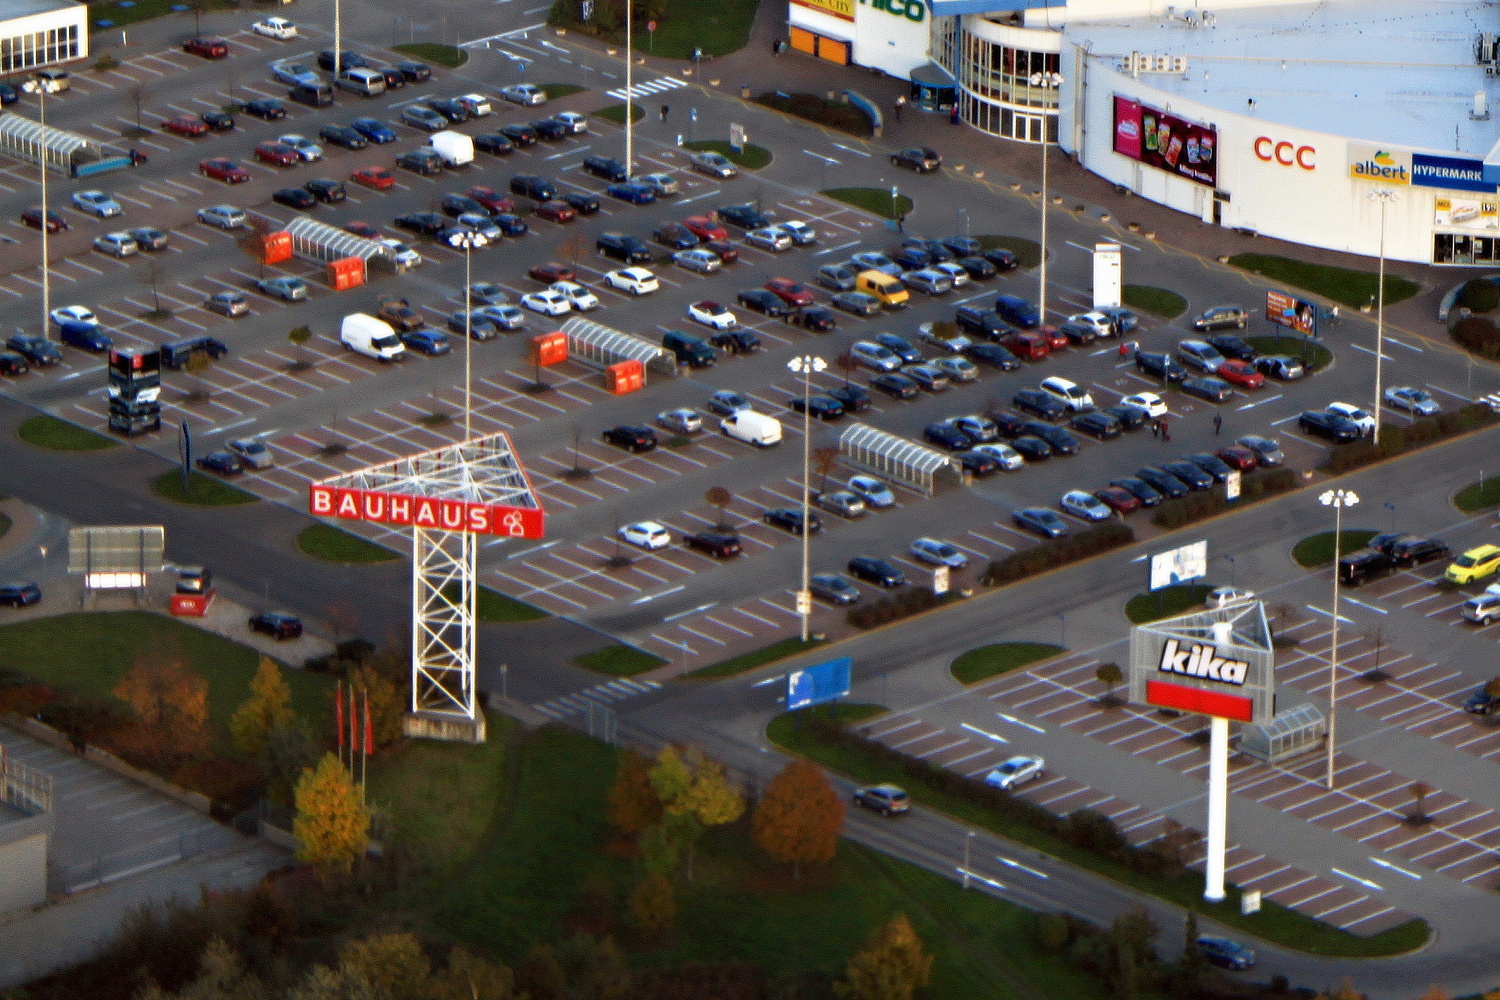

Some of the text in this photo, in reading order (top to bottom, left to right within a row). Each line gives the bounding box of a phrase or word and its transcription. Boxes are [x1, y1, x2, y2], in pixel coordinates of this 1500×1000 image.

[1253, 136, 1317, 171] CCC
[1354, 160, 1483, 182] albert HYPERMARK
[313, 489, 489, 531] BAUHAUS
[1159, 637, 1250, 686] kika
